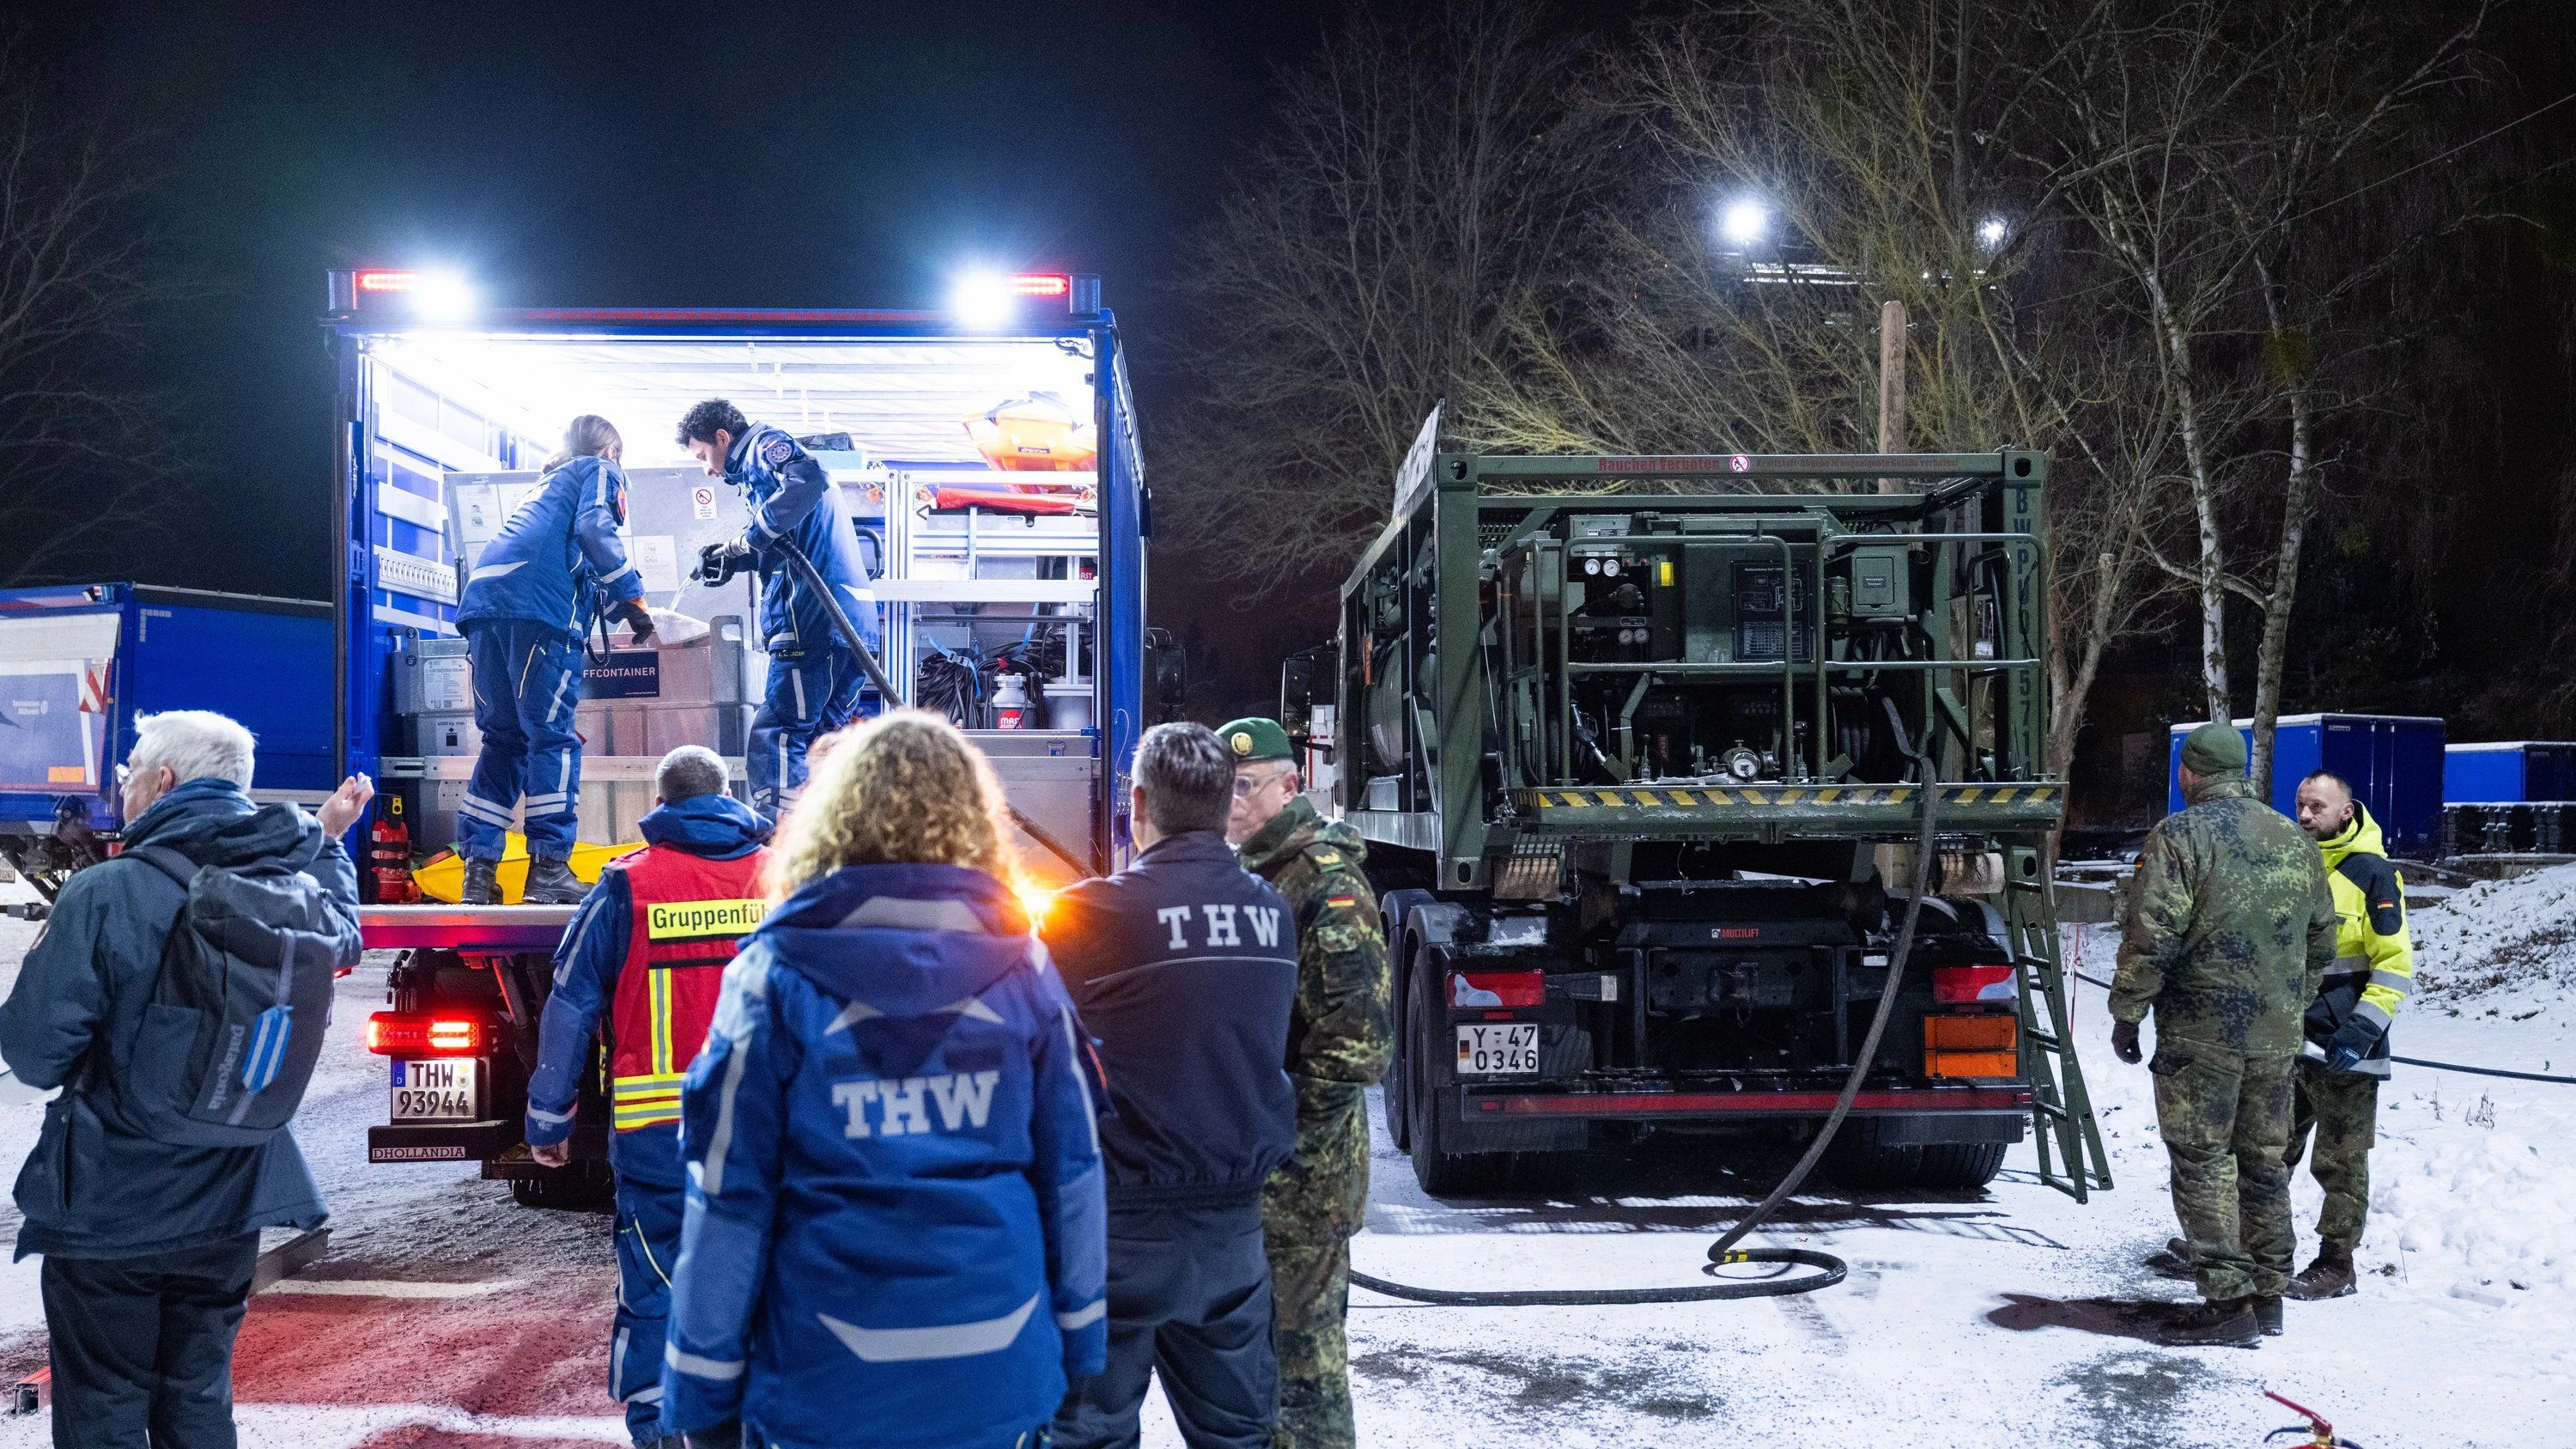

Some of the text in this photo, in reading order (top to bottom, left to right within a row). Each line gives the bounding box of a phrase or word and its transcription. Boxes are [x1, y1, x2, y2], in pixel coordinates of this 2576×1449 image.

[1599, 457, 1719, 471] Rauchen Verboten
[583, 667, 656, 678] FFCONTAINER
[653, 904, 771, 930] Gruppenfüh
[1157, 904, 1279, 950] THW
[1722, 928, 1759, 937] MULTILIFT
[1475, 1050, 1537, 1070] 0346
[411, 1063, 453, 1087] THW
[399, 1091, 468, 1116] 93944
[831, 1070, 1000, 1139] THW
[374, 1148, 465, 1159] DHOLLANDIA
